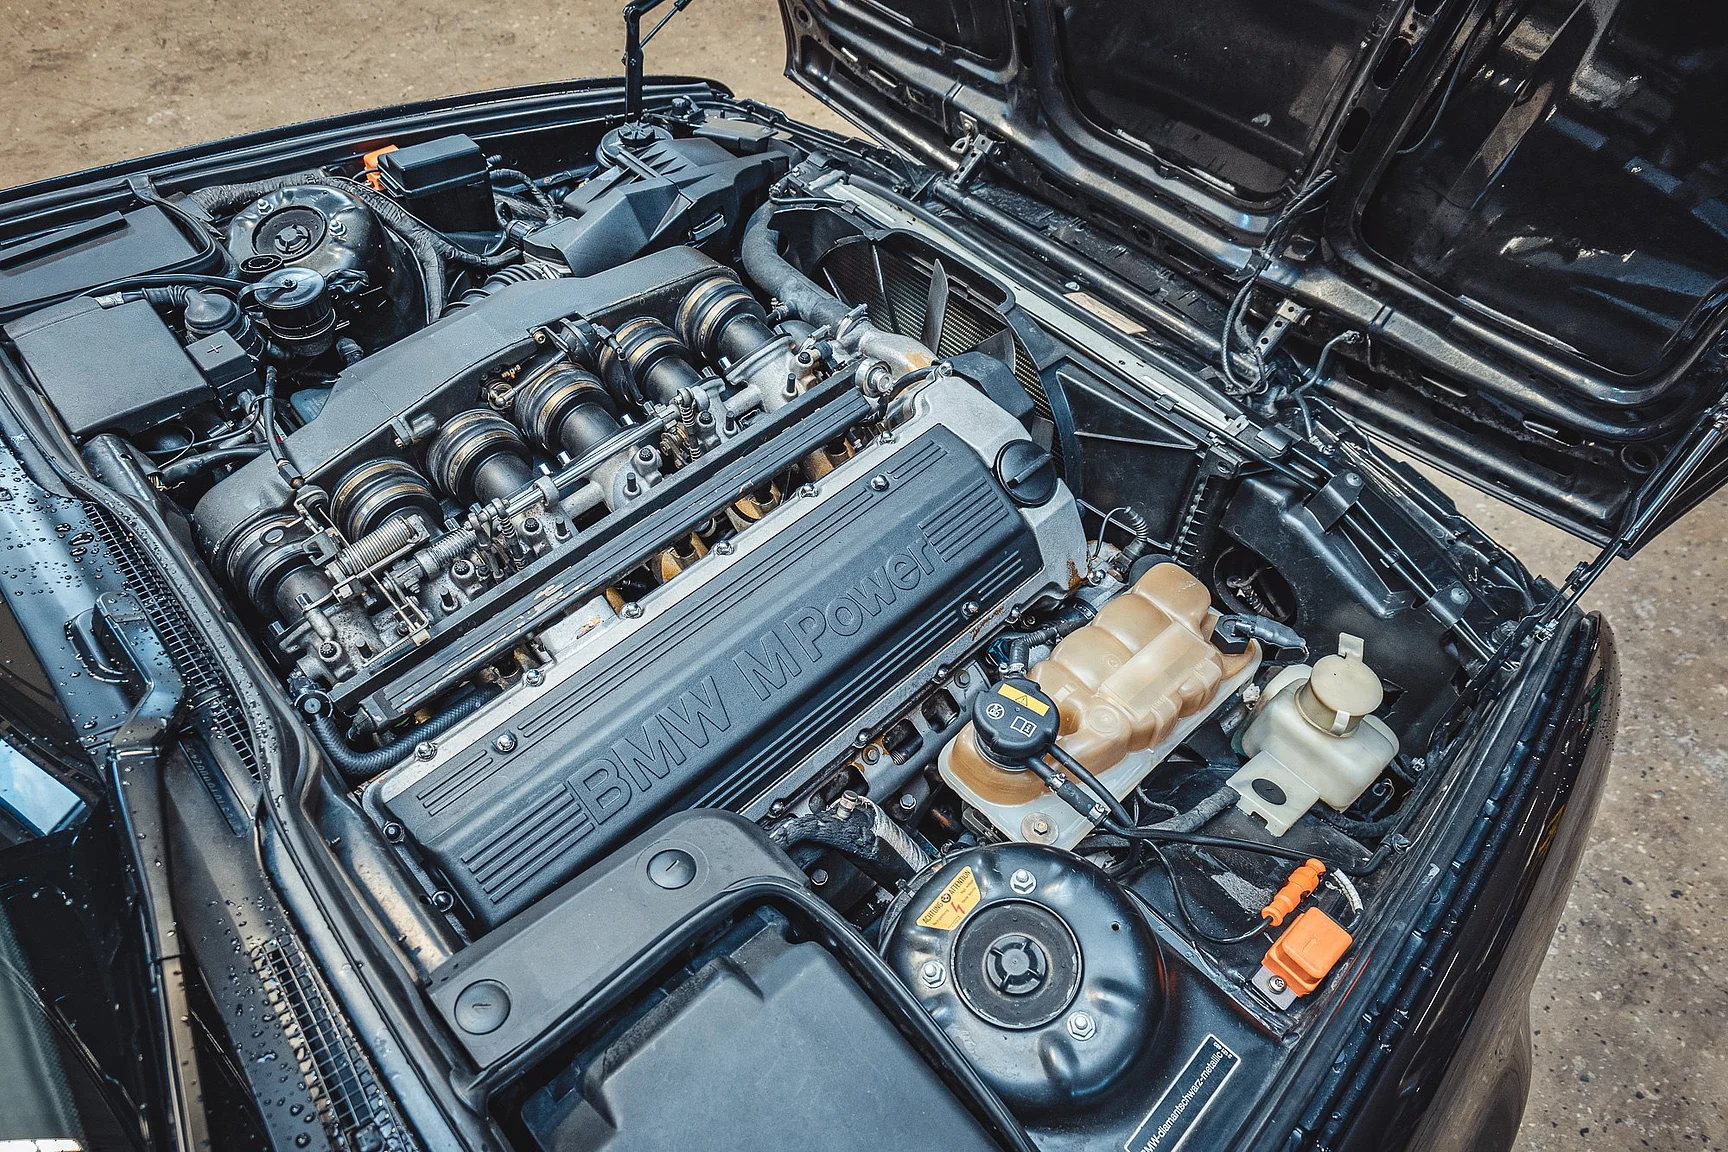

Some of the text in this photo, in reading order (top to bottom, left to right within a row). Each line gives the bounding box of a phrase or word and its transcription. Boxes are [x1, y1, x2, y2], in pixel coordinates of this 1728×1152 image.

[567, 674, 732, 825] BMW
[922, 901, 944, 924] ACHTUNG
[949, 870, 971, 896] ATTENTION
